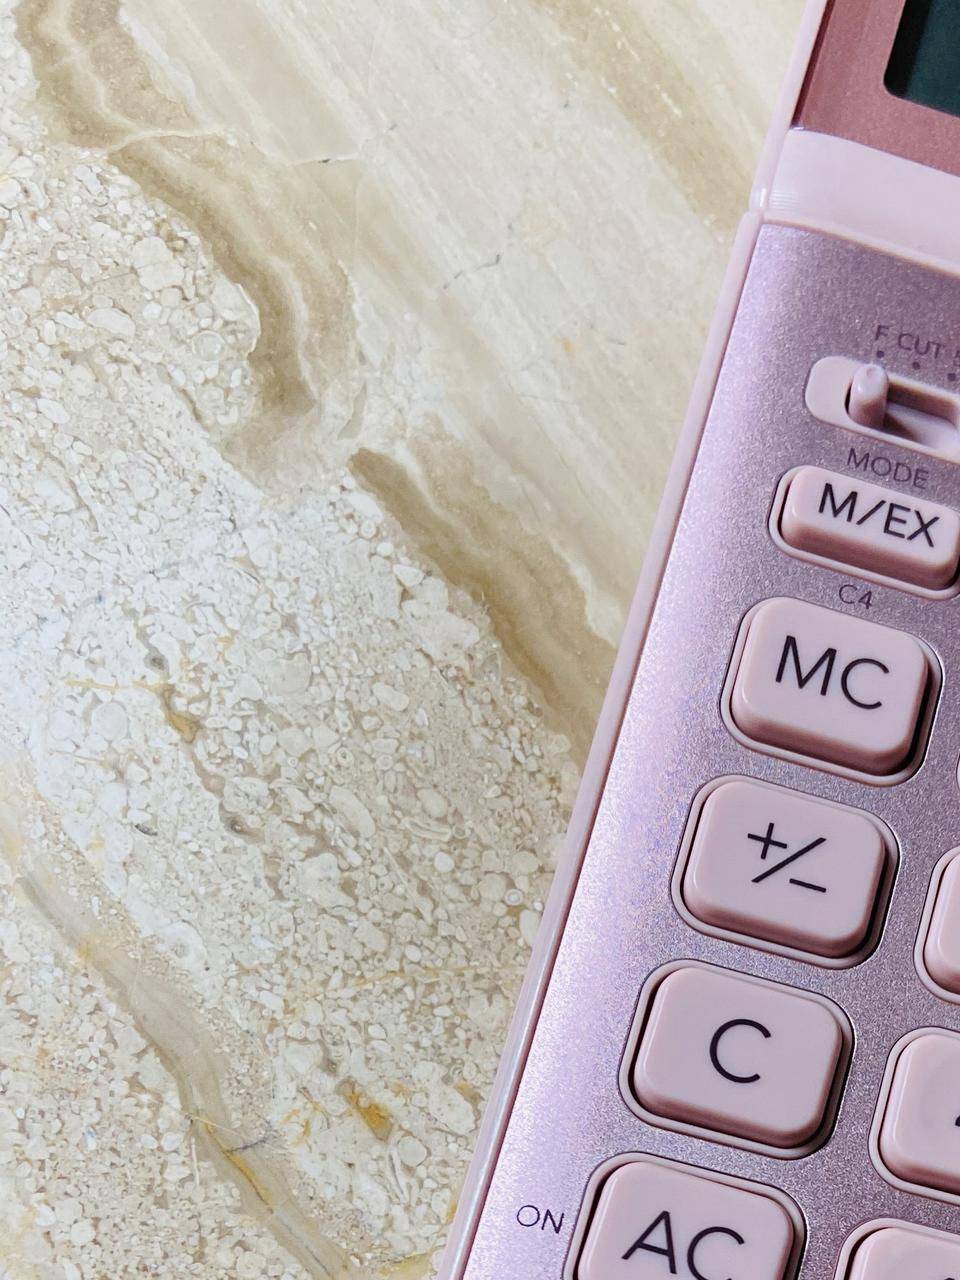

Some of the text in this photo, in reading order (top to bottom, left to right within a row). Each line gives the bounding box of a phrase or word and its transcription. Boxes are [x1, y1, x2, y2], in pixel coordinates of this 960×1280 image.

[875, 324, 890, 341] F
[898, 333, 945, 359] CUT
[846, 448, 929, 490] MODE
[818, 483, 940, 549] M/EX
[838, 583, 873, 610] C4
[775, 634, 890, 710] MC
[709, 1018, 772, 1084] C
[516, 1204, 565, 1235] ON
